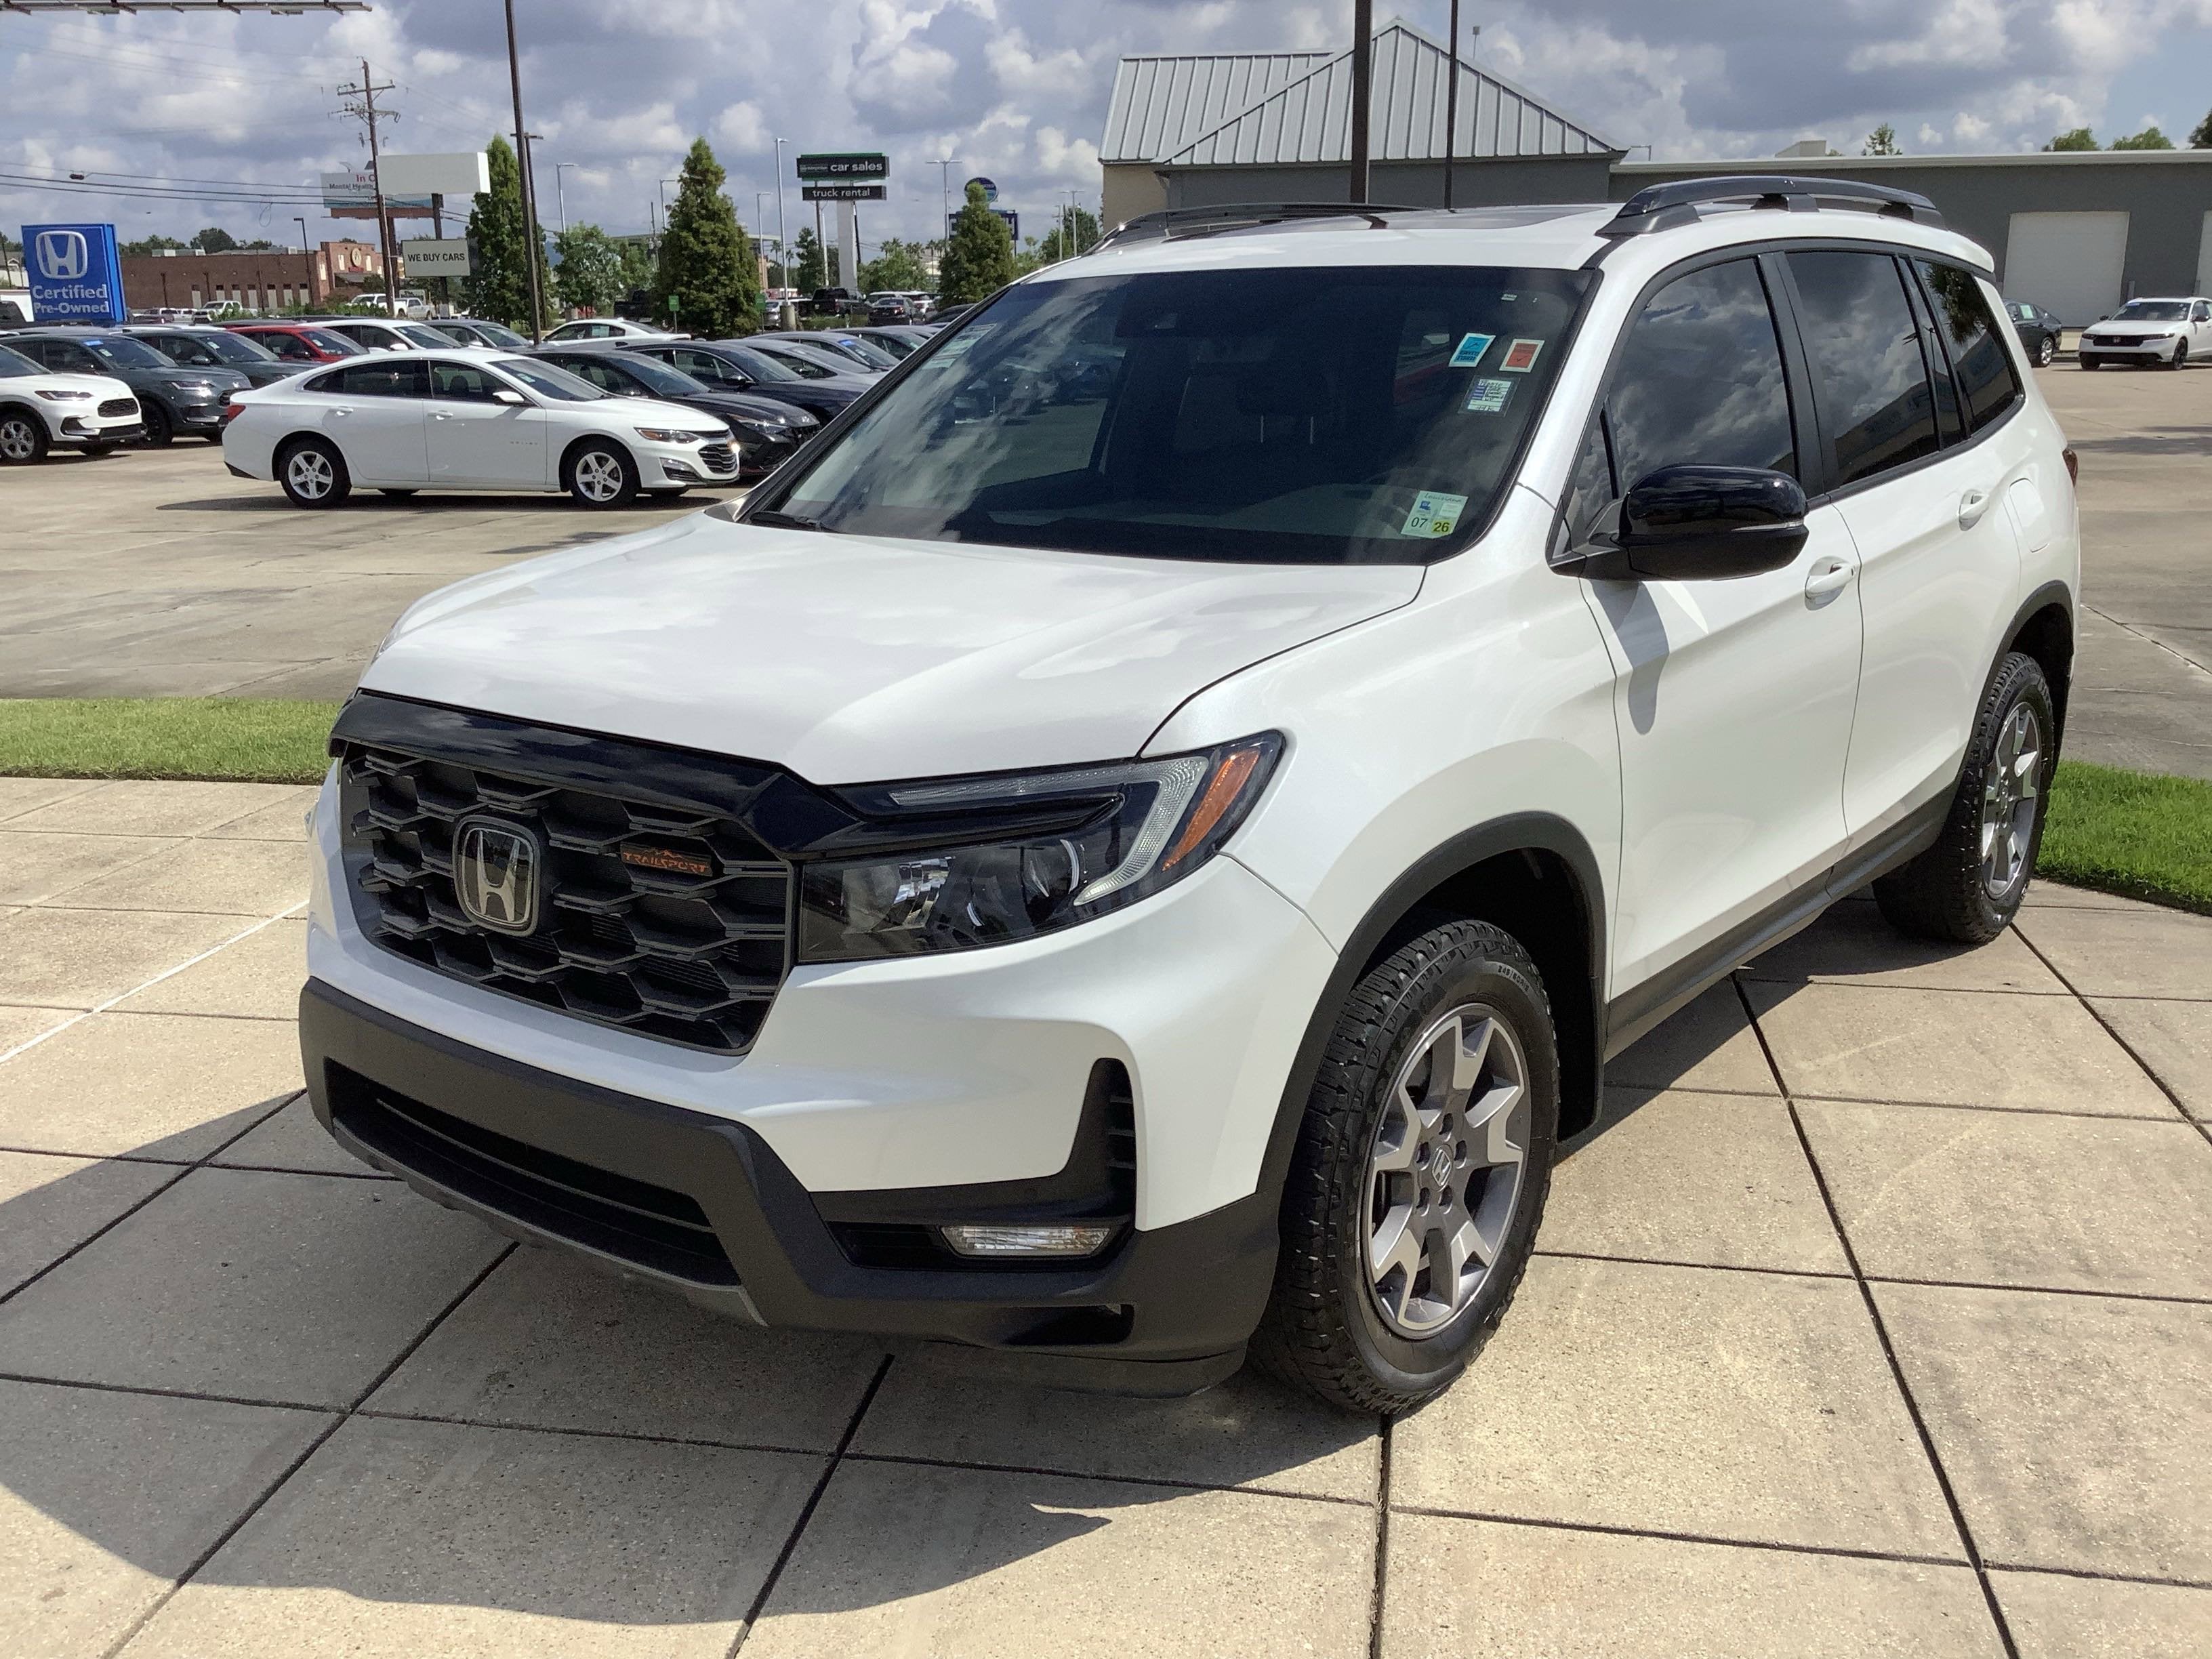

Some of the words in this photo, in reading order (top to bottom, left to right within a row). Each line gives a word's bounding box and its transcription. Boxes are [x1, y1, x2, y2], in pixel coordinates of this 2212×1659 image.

[852, 161, 883, 171] sales
[812, 188, 838, 197] truck
[841, 188, 870, 197] rental
[407, 254, 421, 262] WE
[424, 253, 441, 262] BUY
[442, 253, 466, 261] CARS
[33, 284, 108, 300] Certified
[34, 301, 110, 314] Pre-Owned
[1411, 517, 1429, 528] 07
[1433, 522, 1450, 533] 26
[623, 852, 710, 874] TRAILSPORT
